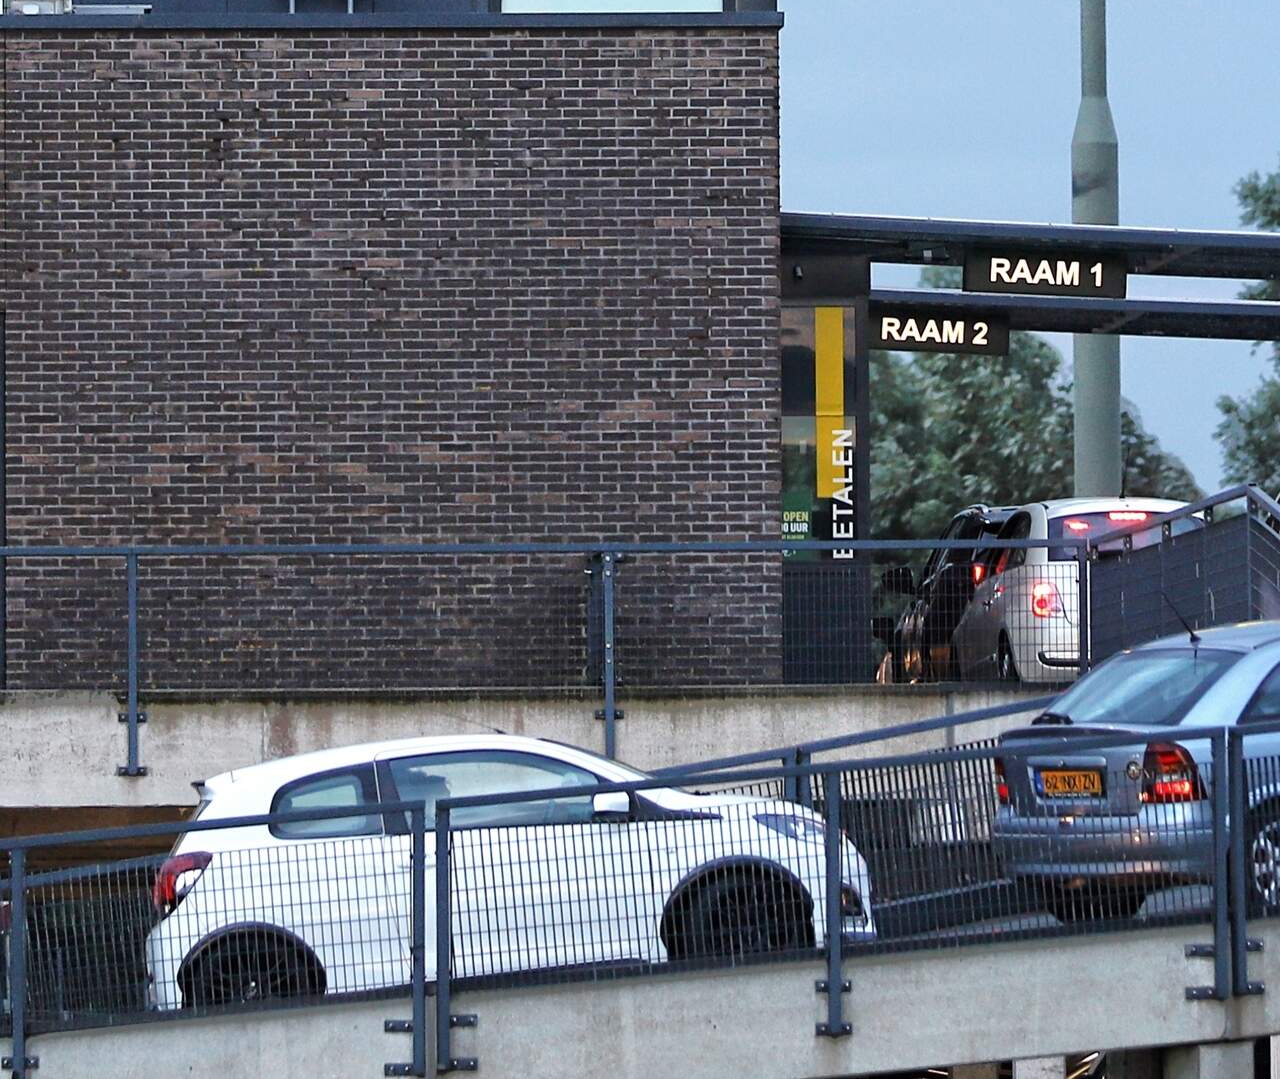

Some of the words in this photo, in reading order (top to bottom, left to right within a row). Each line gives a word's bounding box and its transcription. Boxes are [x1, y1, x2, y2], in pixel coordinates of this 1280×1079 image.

[989, 257, 1080, 286] RAAM
[1090, 262, 1103, 287] 1
[881, 316, 965, 344] RAAM
[972, 322, 989, 346] 2
